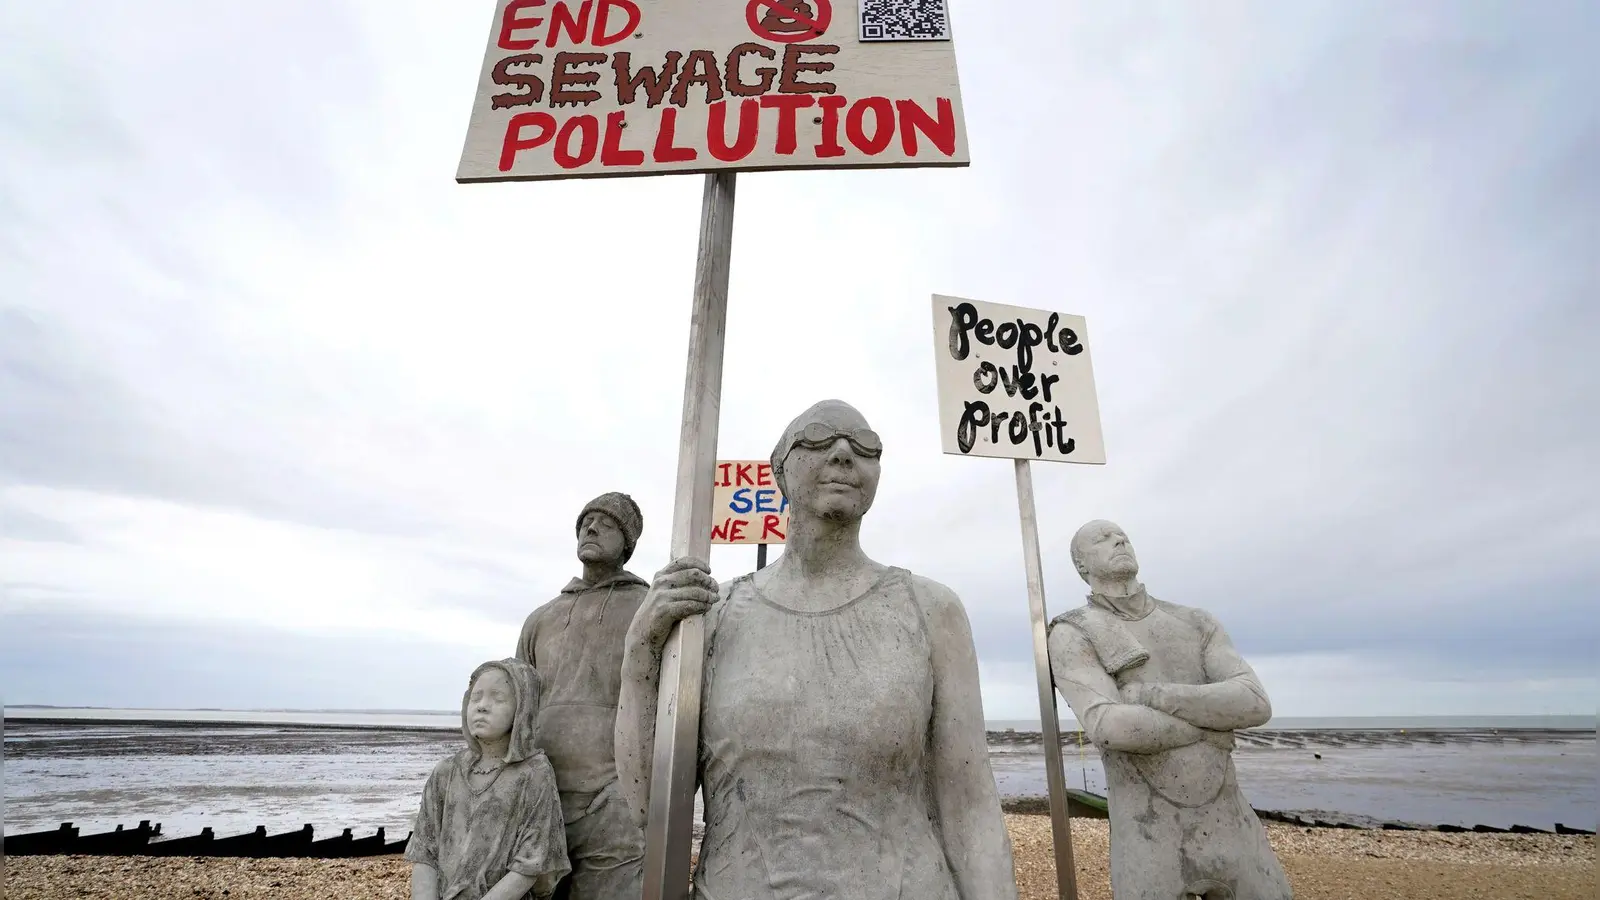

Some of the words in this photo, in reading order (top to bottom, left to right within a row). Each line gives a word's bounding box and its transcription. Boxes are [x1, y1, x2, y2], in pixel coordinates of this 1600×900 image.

[498, 0, 641, 49] END
[491, 43, 840, 109] SEWAGE
[499, 96, 955, 171] POLLUTION
[948, 303, 1083, 373] People
[973, 361, 1059, 402] over
[714, 463, 772, 487] IKE
